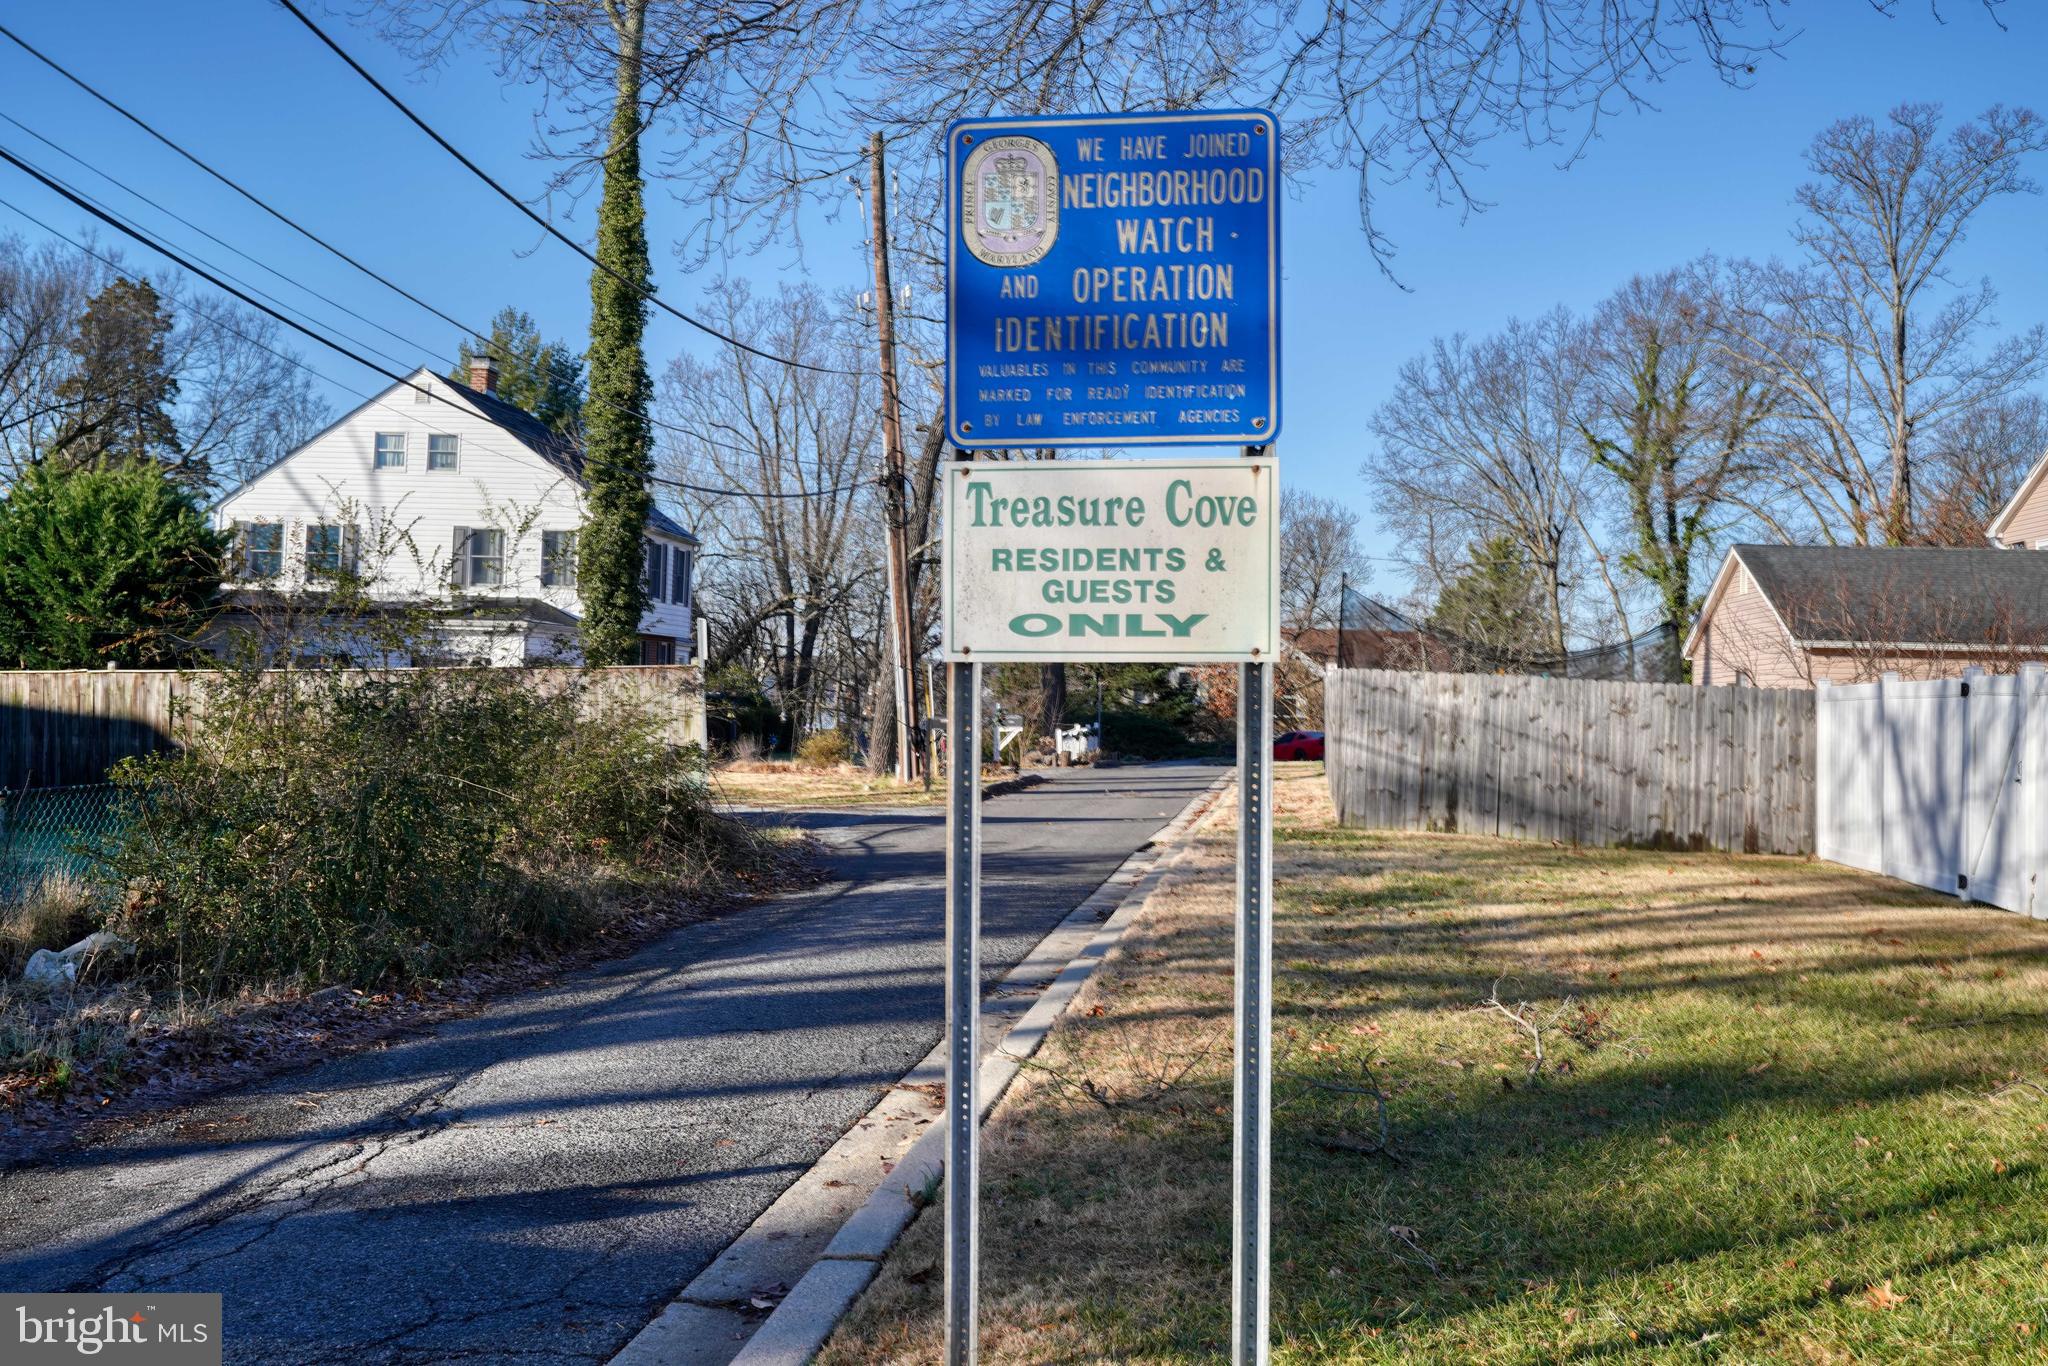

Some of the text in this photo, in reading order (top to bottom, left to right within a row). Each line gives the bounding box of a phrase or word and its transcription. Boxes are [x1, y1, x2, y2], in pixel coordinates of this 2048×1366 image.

[1076, 133, 1251, 162] WE HAVE JOINED
[1063, 167, 1265, 209] NEIGHBORHOOD
[1116, 217, 1214, 254] WATCH
[1000, 264, 1234, 303] AND OPERATION
[995, 312, 1229, 352] IDENTIFICATION
[979, 358, 1246, 378] VALUABLES IN THIS COMMUNITY ARE
[979, 384, 1246, 402] MARKED FOR READY IDENTIFICATION
[984, 408, 1240, 427] BY LAW ENFORCEMENT AGENCIES
[965, 479, 1258, 528] Treasure Cove
[991, 547, 1228, 572] RESIDENTS &
[1041, 579, 1176, 604] GUESTS
[1008, 613, 1209, 638] ONLY
